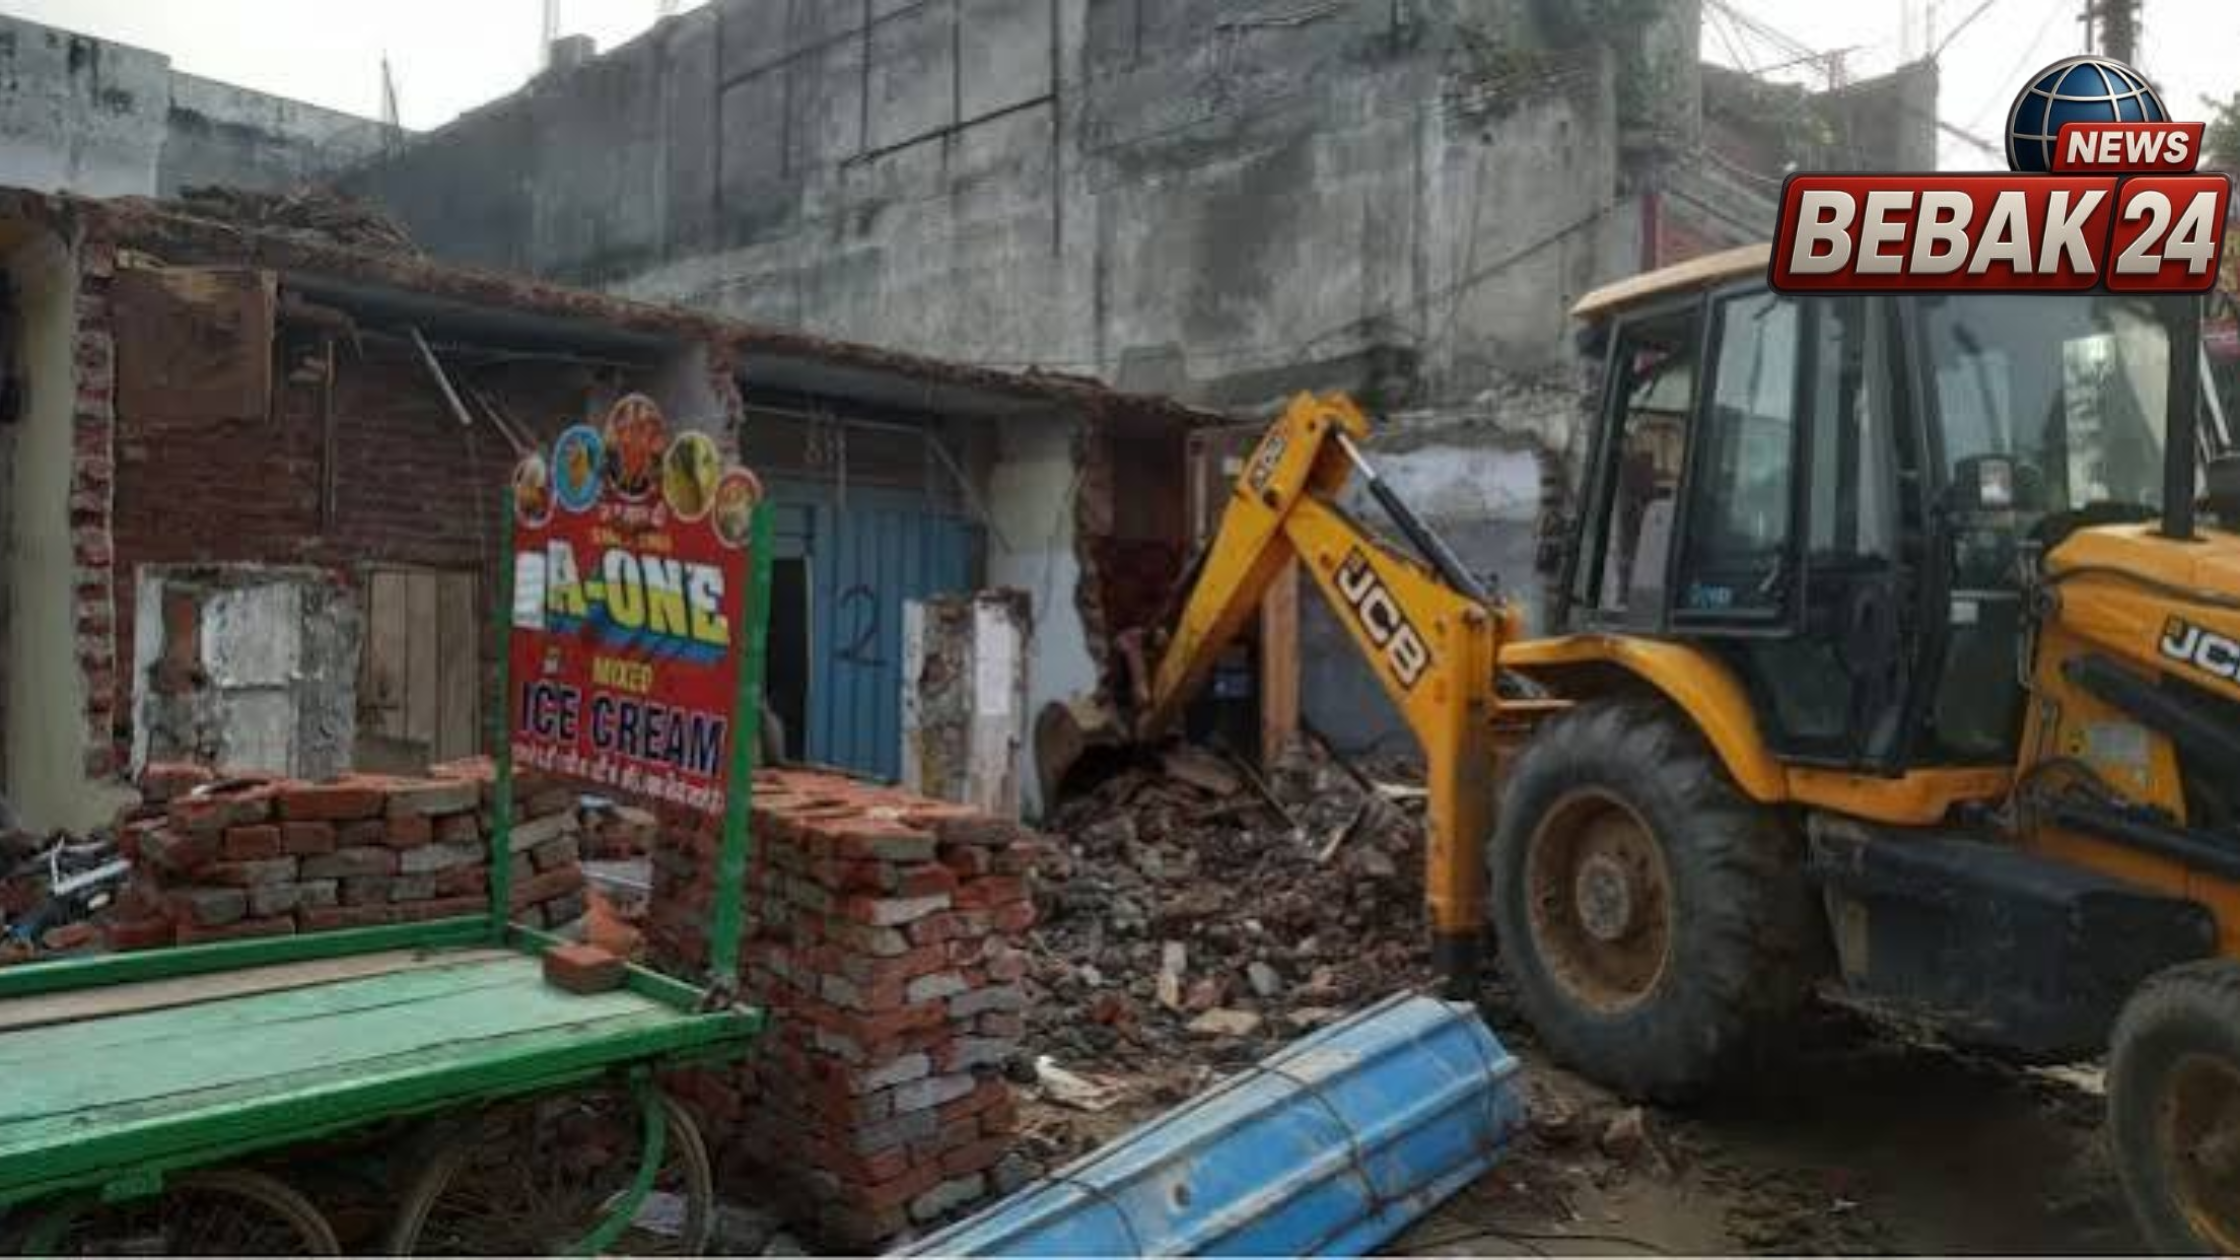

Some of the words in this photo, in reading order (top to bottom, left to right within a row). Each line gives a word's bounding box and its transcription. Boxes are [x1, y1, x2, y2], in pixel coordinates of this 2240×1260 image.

[545, 539, 731, 648] A-ONE
[1334, 548, 1429, 687] JCB
[592, 656, 655, 693] MIXED
[2160, 614, 2240, 680] JC
[521, 680, 580, 744] ICE
[592, 694, 728, 779] CREAM
